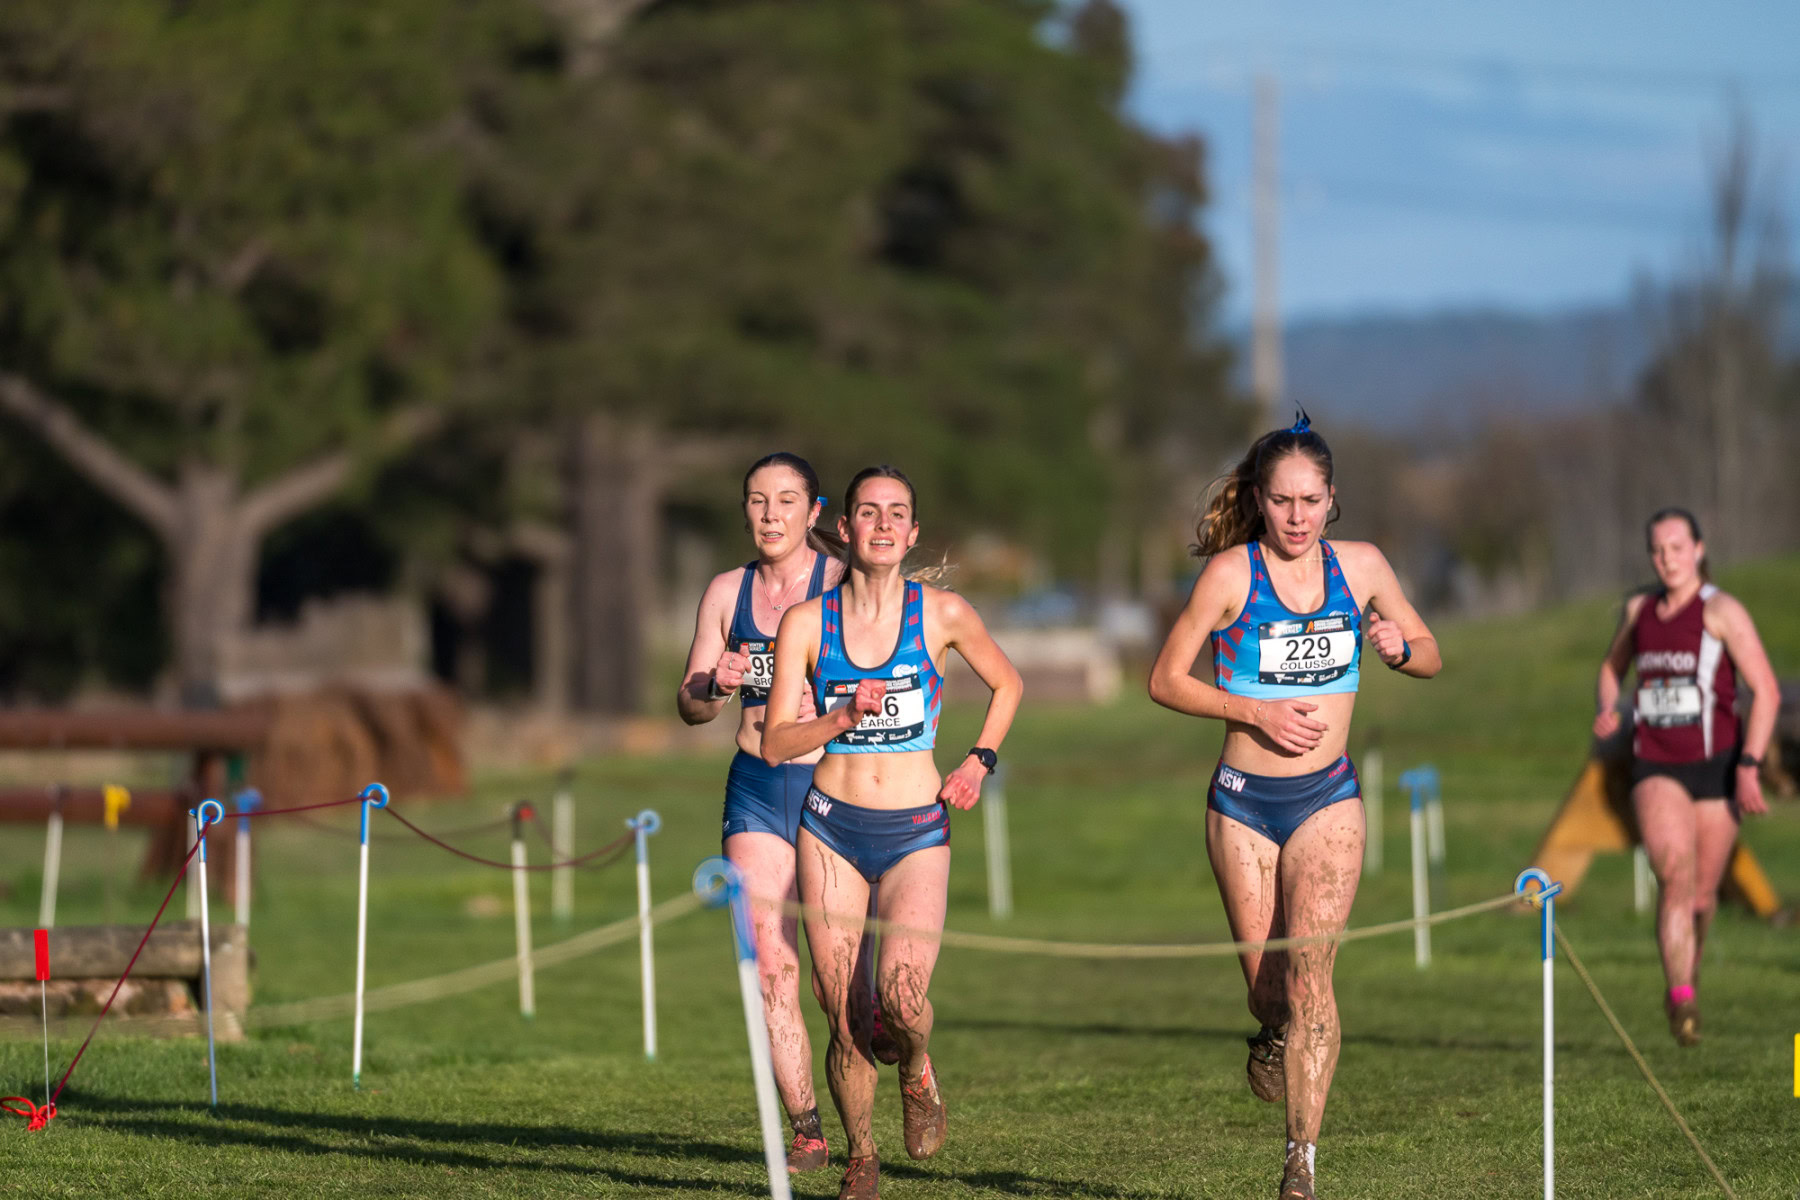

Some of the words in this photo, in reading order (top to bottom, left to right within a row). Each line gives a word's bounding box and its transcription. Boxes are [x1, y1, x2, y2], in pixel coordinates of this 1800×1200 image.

[1286, 636, 1331, 661] 229
[1280, 658, 1336, 670] COLUSSO
[860, 717, 901, 728] EARCE
[1218, 769, 1247, 793] NSW
